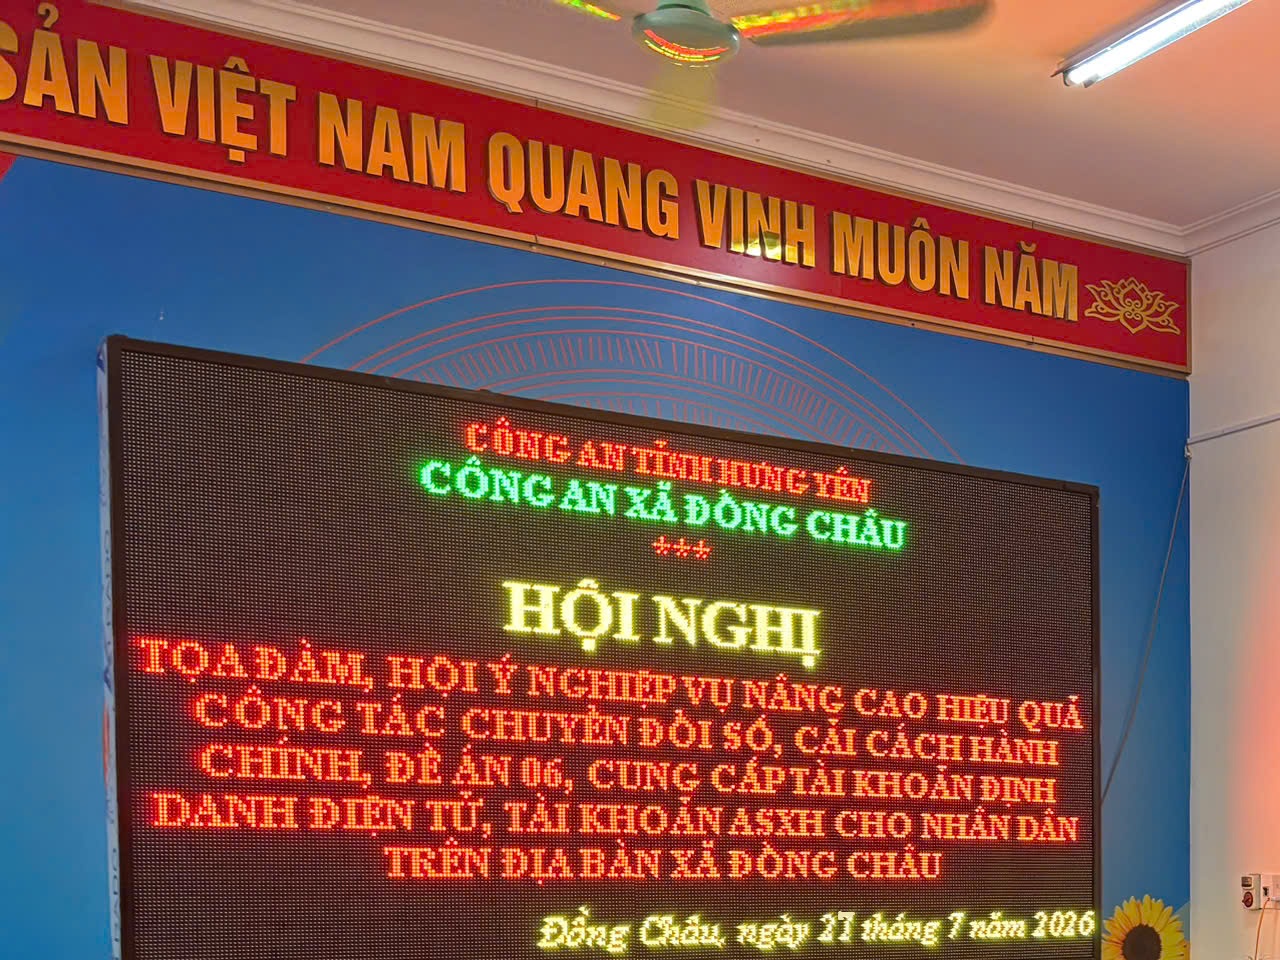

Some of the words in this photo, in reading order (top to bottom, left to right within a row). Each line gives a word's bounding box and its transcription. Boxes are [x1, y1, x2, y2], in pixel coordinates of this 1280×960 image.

[150, 56, 296, 163] VIỆT
[318, 92, 467, 192] NAM
[488, 131, 680, 241] QUANG
[696, 178, 815, 267] VINH
[832, 217, 969, 299] MUÔN
[984, 235, 1079, 322] NĂM
[465, 416, 572, 462] CÔNG
[577, 440, 626, 472] AN
[632, 440, 712, 482] TỈNH
[717, 459, 809, 495] HƯNG
[813, 466, 872, 503] YÊN
[418, 455, 555, 508] CÔNG
[558, 479, 619, 515] AN
[624, 480, 679, 522] XÃ
[684, 489, 799, 536] ĐỒNG
[806, 508, 908, 550] CHÂU
[503, 578, 641, 653] HỘI
[652, 595, 823, 669] NGHỊ
[135, 637, 249, 684] TỌA
[254, 638, 374, 693] ĐÀM,
[386, 655, 478, 697] HỘI
[486, 653, 518, 694] Ý
[526, 665, 677, 709] NGHIỆP
[682, 676, 734, 713] VỤ
[741, 673, 845, 714] NÂNG
[853, 688, 928, 719] CAO
[937, 694, 1010, 729] HIỆU
[1018, 695, 1084, 732] QUẢ
[193, 684, 345, 732] CÔNG
[355, 692, 445, 737] TÁC
[461, 704, 631, 746] CHUYỂN
[638, 708, 713, 749] ĐỔI
[723, 714, 782, 758] SỐ,
[794, 718, 857, 756] CẢI
[866, 722, 963, 762] CÁCH
[969, 729, 1059, 766] HÀNH
[200, 736, 372, 788] CHÍNH,
[385, 742, 442, 785] ĐỀ
[451, 743, 512, 786] ÁN
[519, 757, 574, 794] 06,
[587, 758, 701, 792] CUNG
[711, 757, 786, 794] CẤP
[789, 759, 846, 797] TÀI
[851, 765, 974, 801] KHOẢN
[980, 775, 1057, 808] ĐỊNH
[149, 791, 300, 830] DANH
[308, 794, 416, 838] ĐIỆN
[425, 790, 492, 839] TỬ,
[503, 792, 571, 835] TÀI
[578, 796, 724, 836] KHOẢN
[727, 807, 826, 837] ASXH
[833, 810, 913, 839] CHO
[920, 805, 1012, 841] NHÂN
[1016, 807, 1080, 842] DÂN
[383, 836, 492, 878] TRÊN
[500, 848, 575, 887] ĐỊA
[579, 838, 662, 879] BÀN
[669, 839, 721, 879] XÃ
[728, 840, 838, 879] ĐỒNG
[846, 843, 944, 880] CHÂU
[537, 904, 632, 955] Đồng
[638, 912, 726, 949] Châu,
[735, 912, 811, 950] ngày
[860, 911, 942, 947] tháng
[948, 911, 966, 940] 7
[968, 911, 1028, 940] năm
[1031, 909, 1096, 938] 2026
